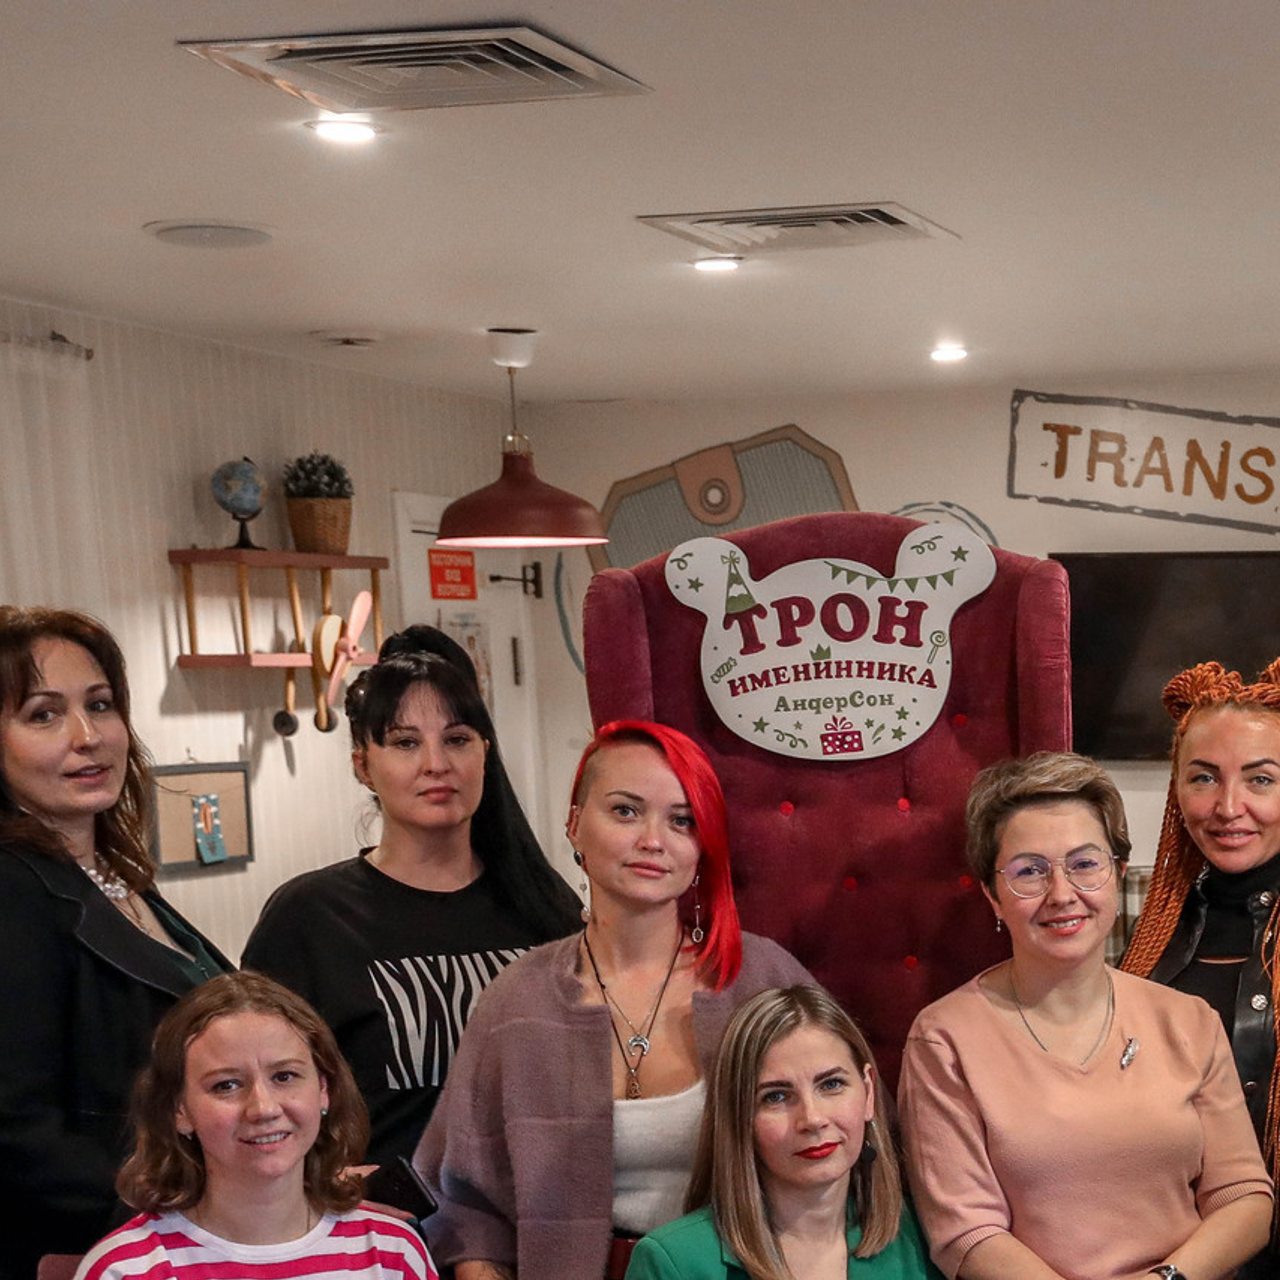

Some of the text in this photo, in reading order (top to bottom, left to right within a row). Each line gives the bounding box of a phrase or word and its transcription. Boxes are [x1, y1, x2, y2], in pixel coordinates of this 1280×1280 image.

[723, 592, 929, 656] ТРОН
[727, 659, 938, 698] ИМЕНИННИКА
[774, 690, 895, 712] АндерСон
